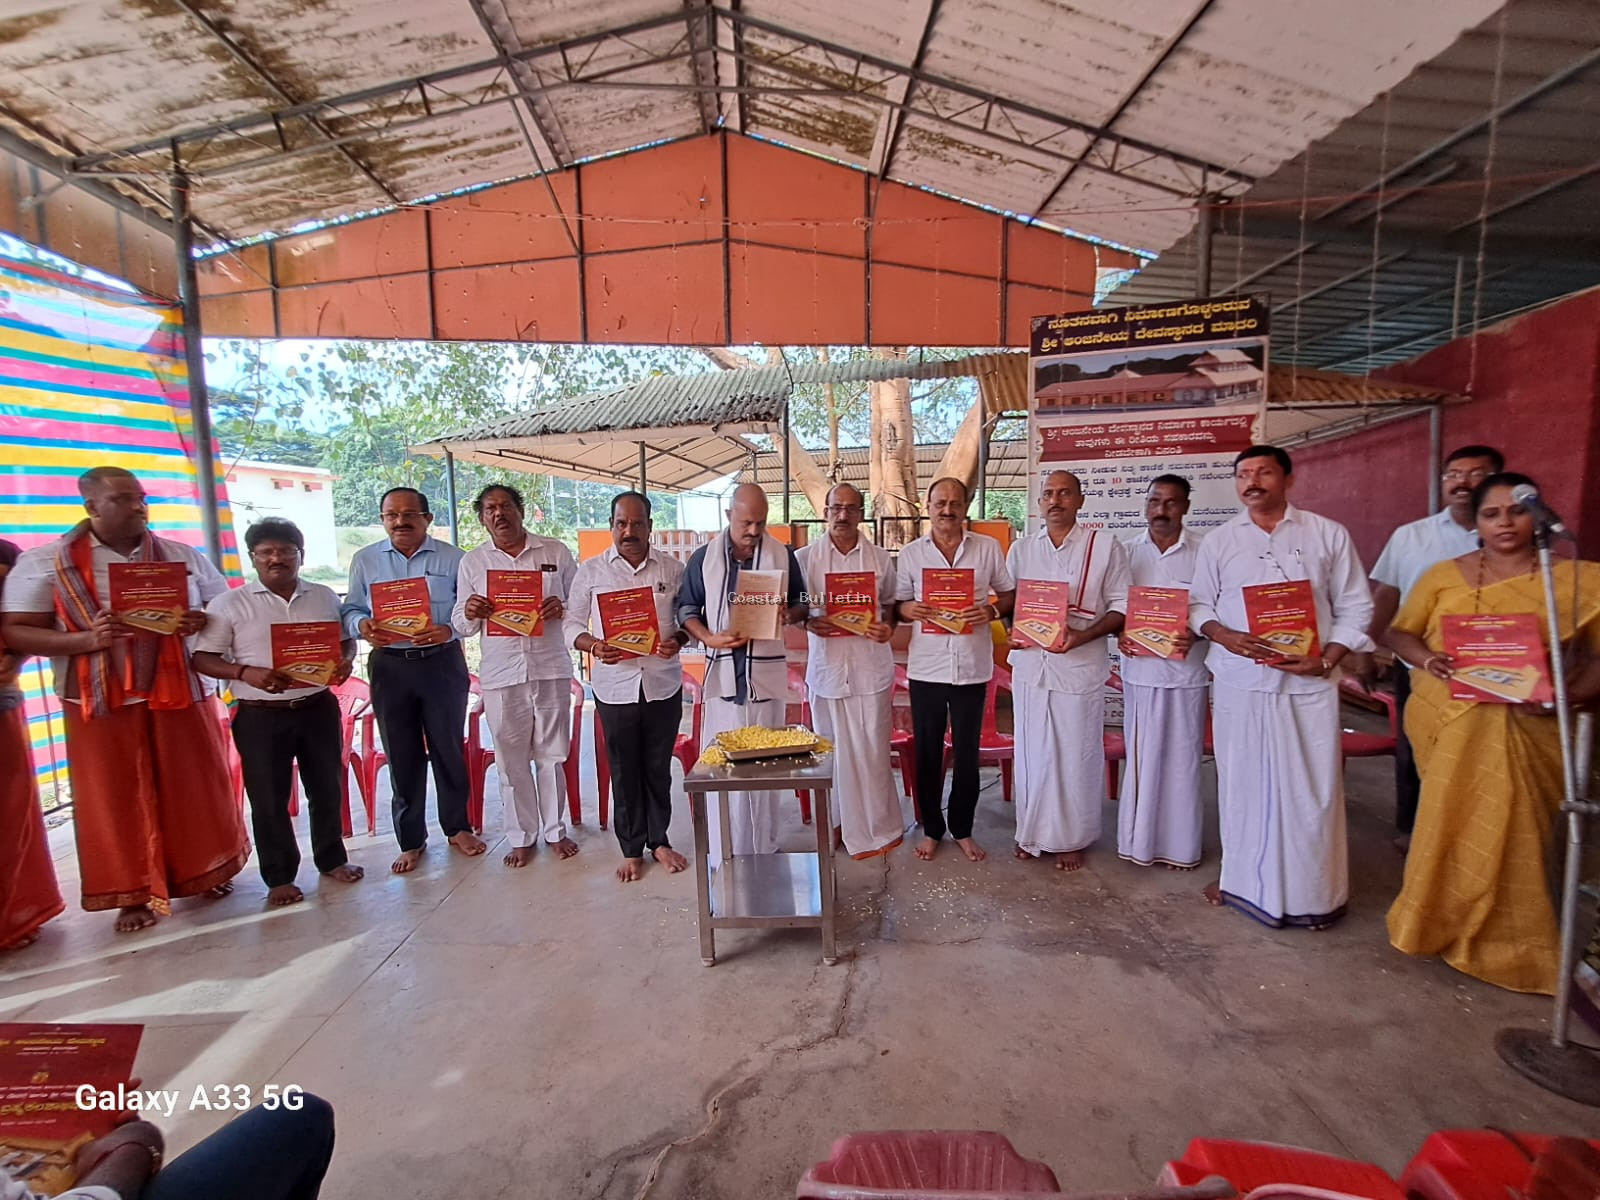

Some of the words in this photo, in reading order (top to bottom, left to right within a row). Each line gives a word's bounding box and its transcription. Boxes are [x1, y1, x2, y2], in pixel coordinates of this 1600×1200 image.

[1048, 313, 1118, 330] ನೂತನವಾಗಿ
[1040, 336, 1058, 352] ಶ್ರೀ
[1135, 322, 1204, 341] ದೇವಸ್ಥಾನದ
[1210, 318, 1257, 333] ಮಾದರಿ
[1112, 477, 1122, 485] 10
